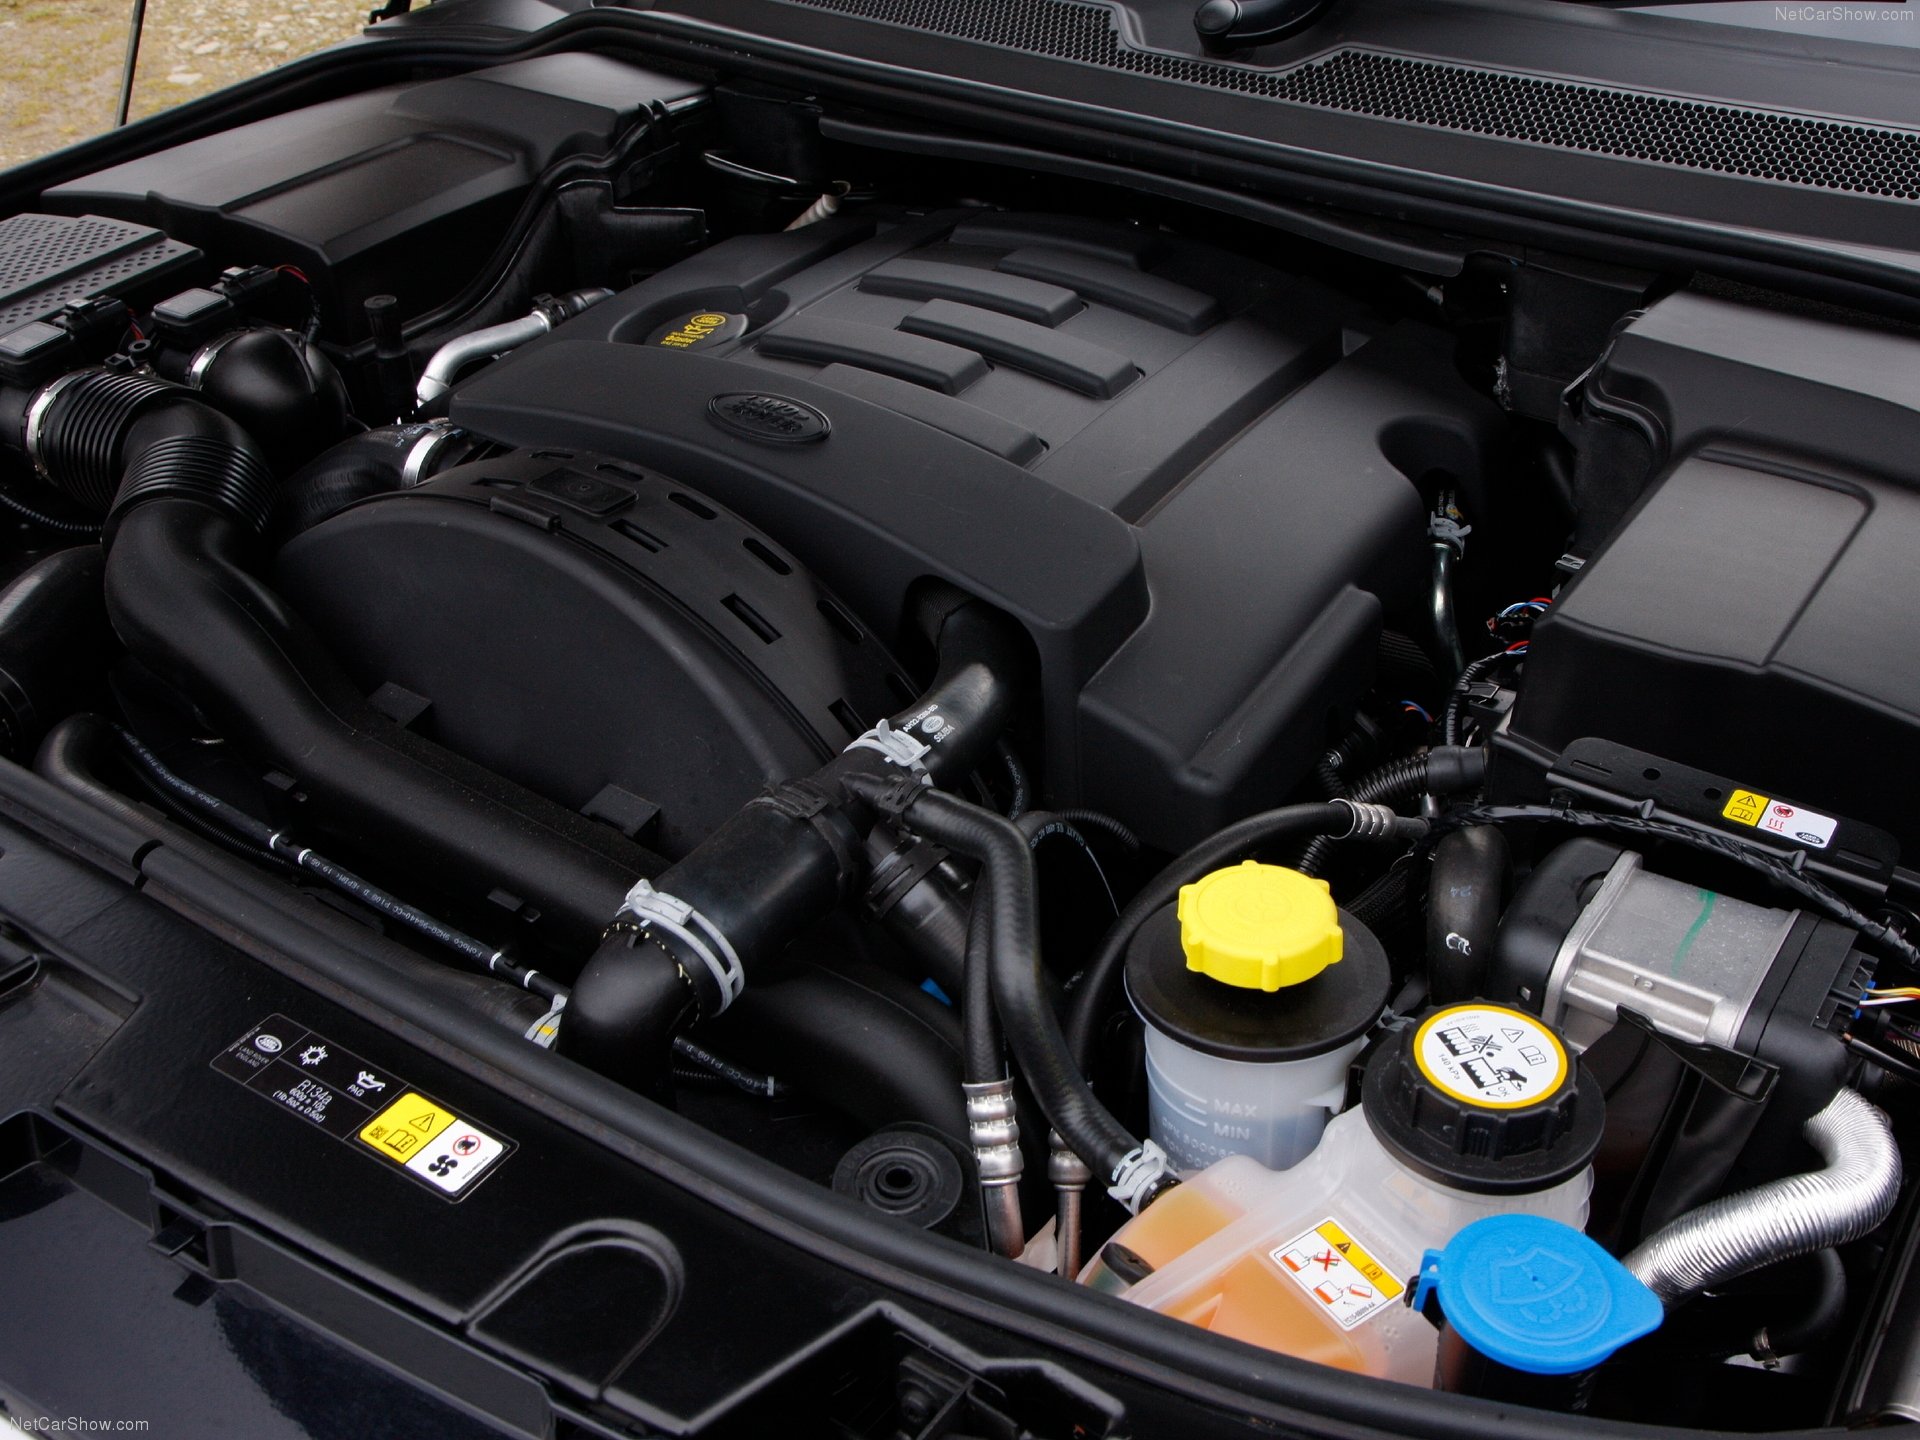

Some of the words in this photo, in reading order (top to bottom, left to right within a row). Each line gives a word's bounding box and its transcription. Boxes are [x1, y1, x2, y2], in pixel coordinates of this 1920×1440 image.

[453, 938, 483, 958] FoMoCo
[1438, 1053, 1451, 1069] 140
[1447, 1064, 1462, 1080] kPa
[297, 1079, 333, 1106] R134a
[346, 1084, 364, 1097] PAG
[1497, 1086, 1510, 1098] OK
[312, 1100, 326, 1112] 10g
[1213, 1098, 1258, 1118] MAX
[1213, 1121, 1251, 1140] MIN
